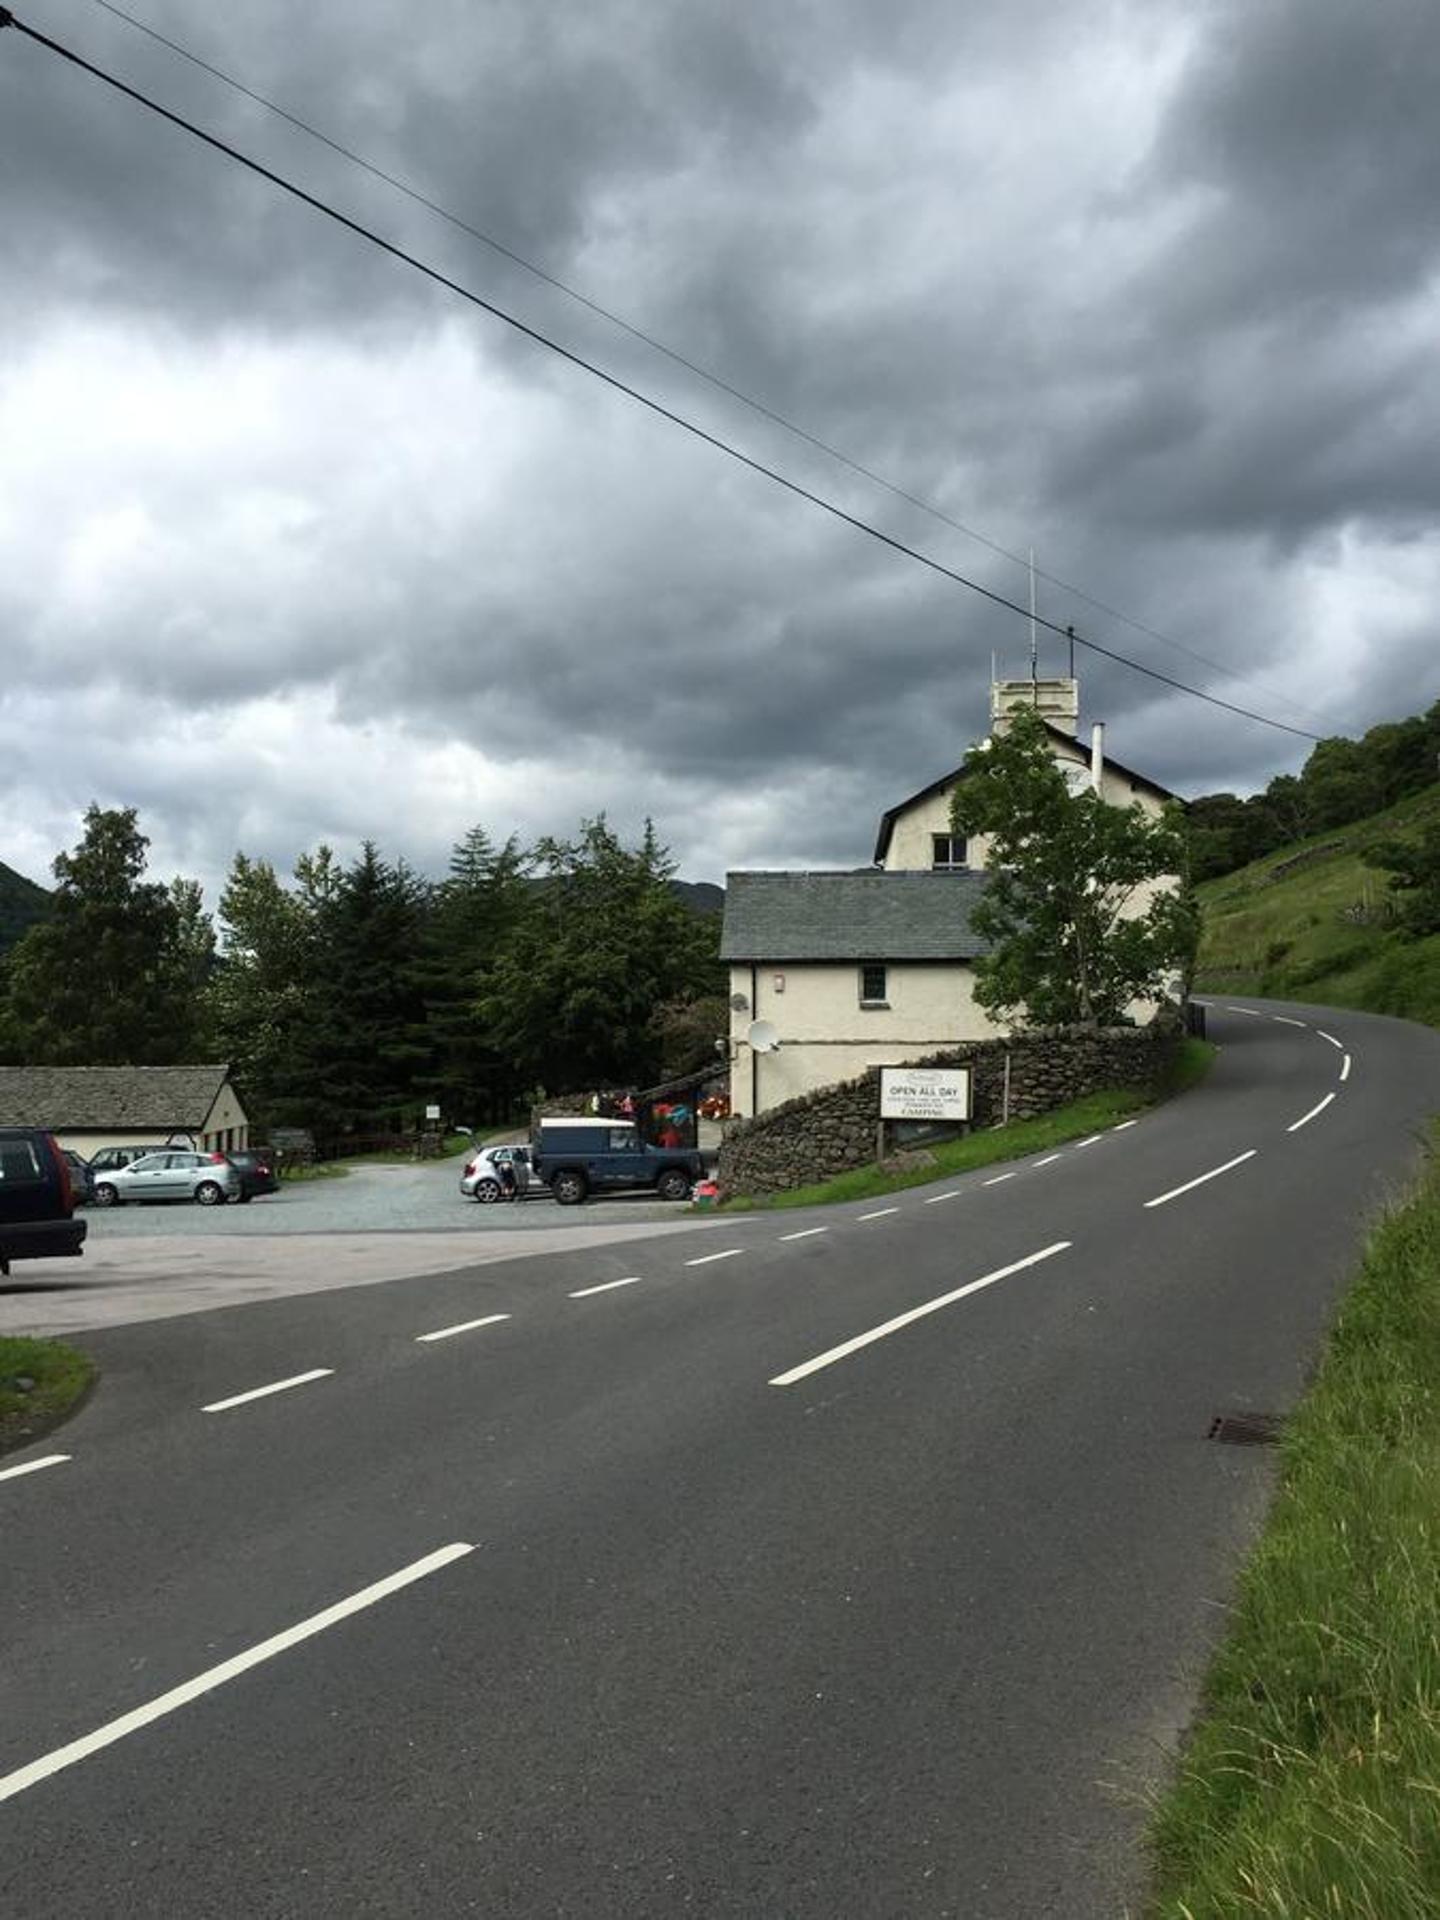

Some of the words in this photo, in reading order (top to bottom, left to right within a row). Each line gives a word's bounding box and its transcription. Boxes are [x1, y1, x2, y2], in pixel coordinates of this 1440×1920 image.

[889, 1086, 917, 1095] OPEN
[919, 1087, 936, 1096] ALL
[938, 1087, 958, 1096] DAY
